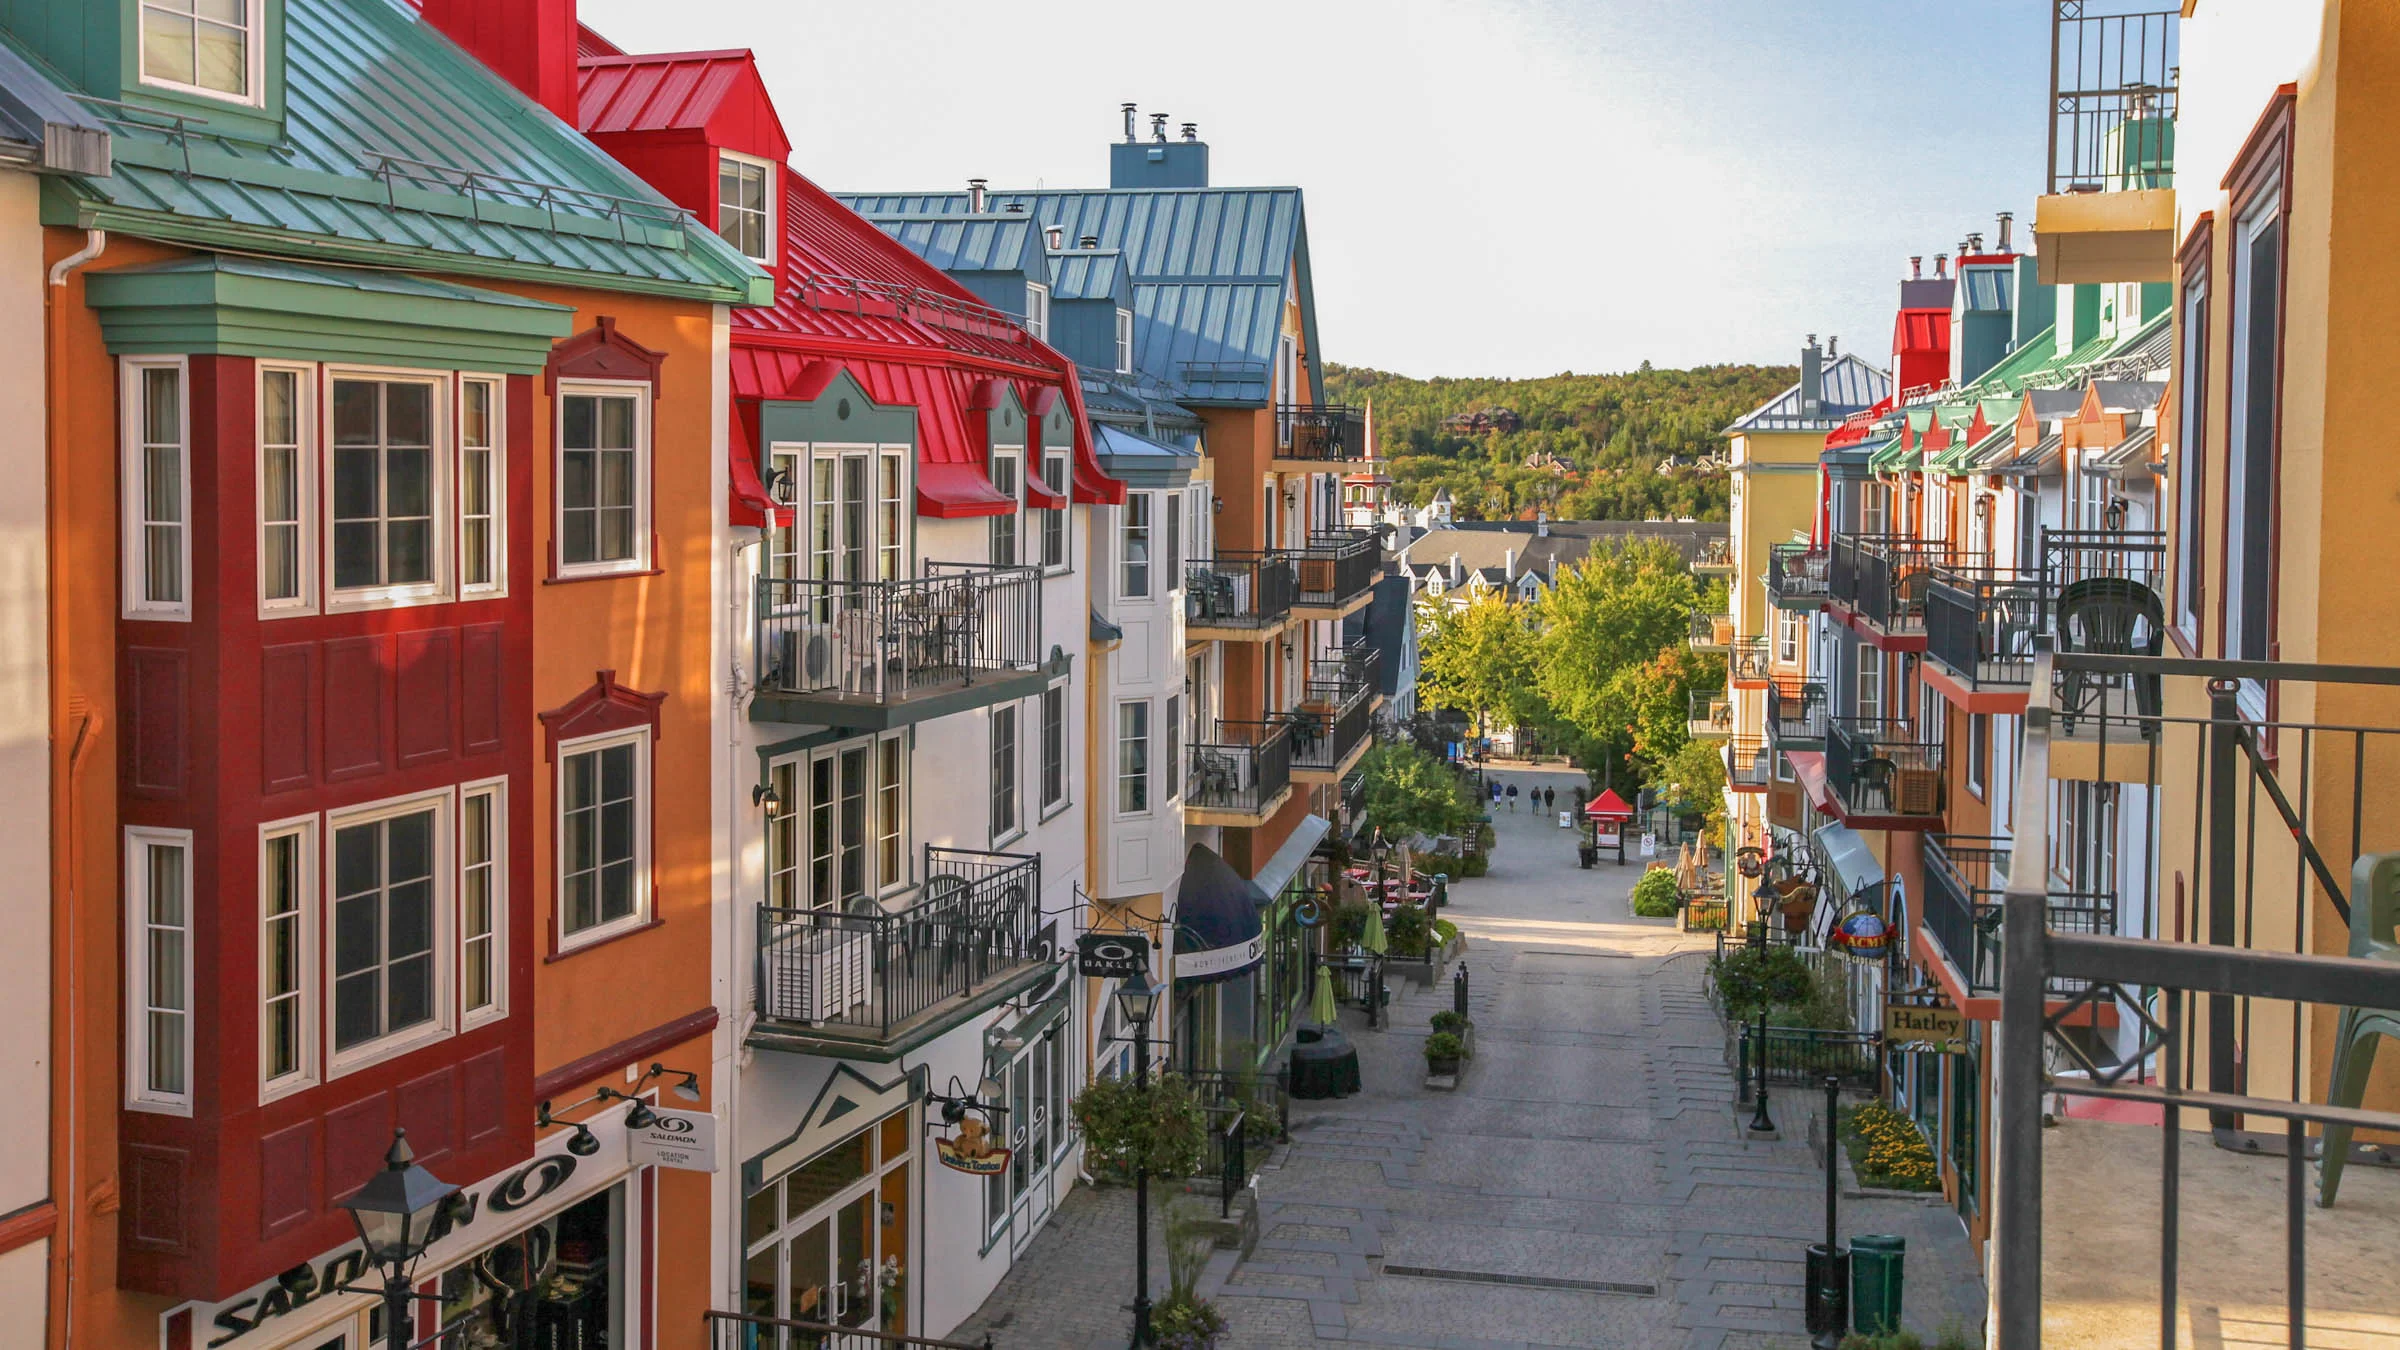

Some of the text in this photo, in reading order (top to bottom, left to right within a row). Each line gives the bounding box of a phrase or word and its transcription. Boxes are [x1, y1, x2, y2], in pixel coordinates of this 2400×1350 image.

[1084, 959, 1134, 969] OAKLE
[1893, 1011, 1960, 1036] Hatley
[649, 1132, 697, 1144] SALOMON
[657, 1150, 690, 1160] LOCATION
